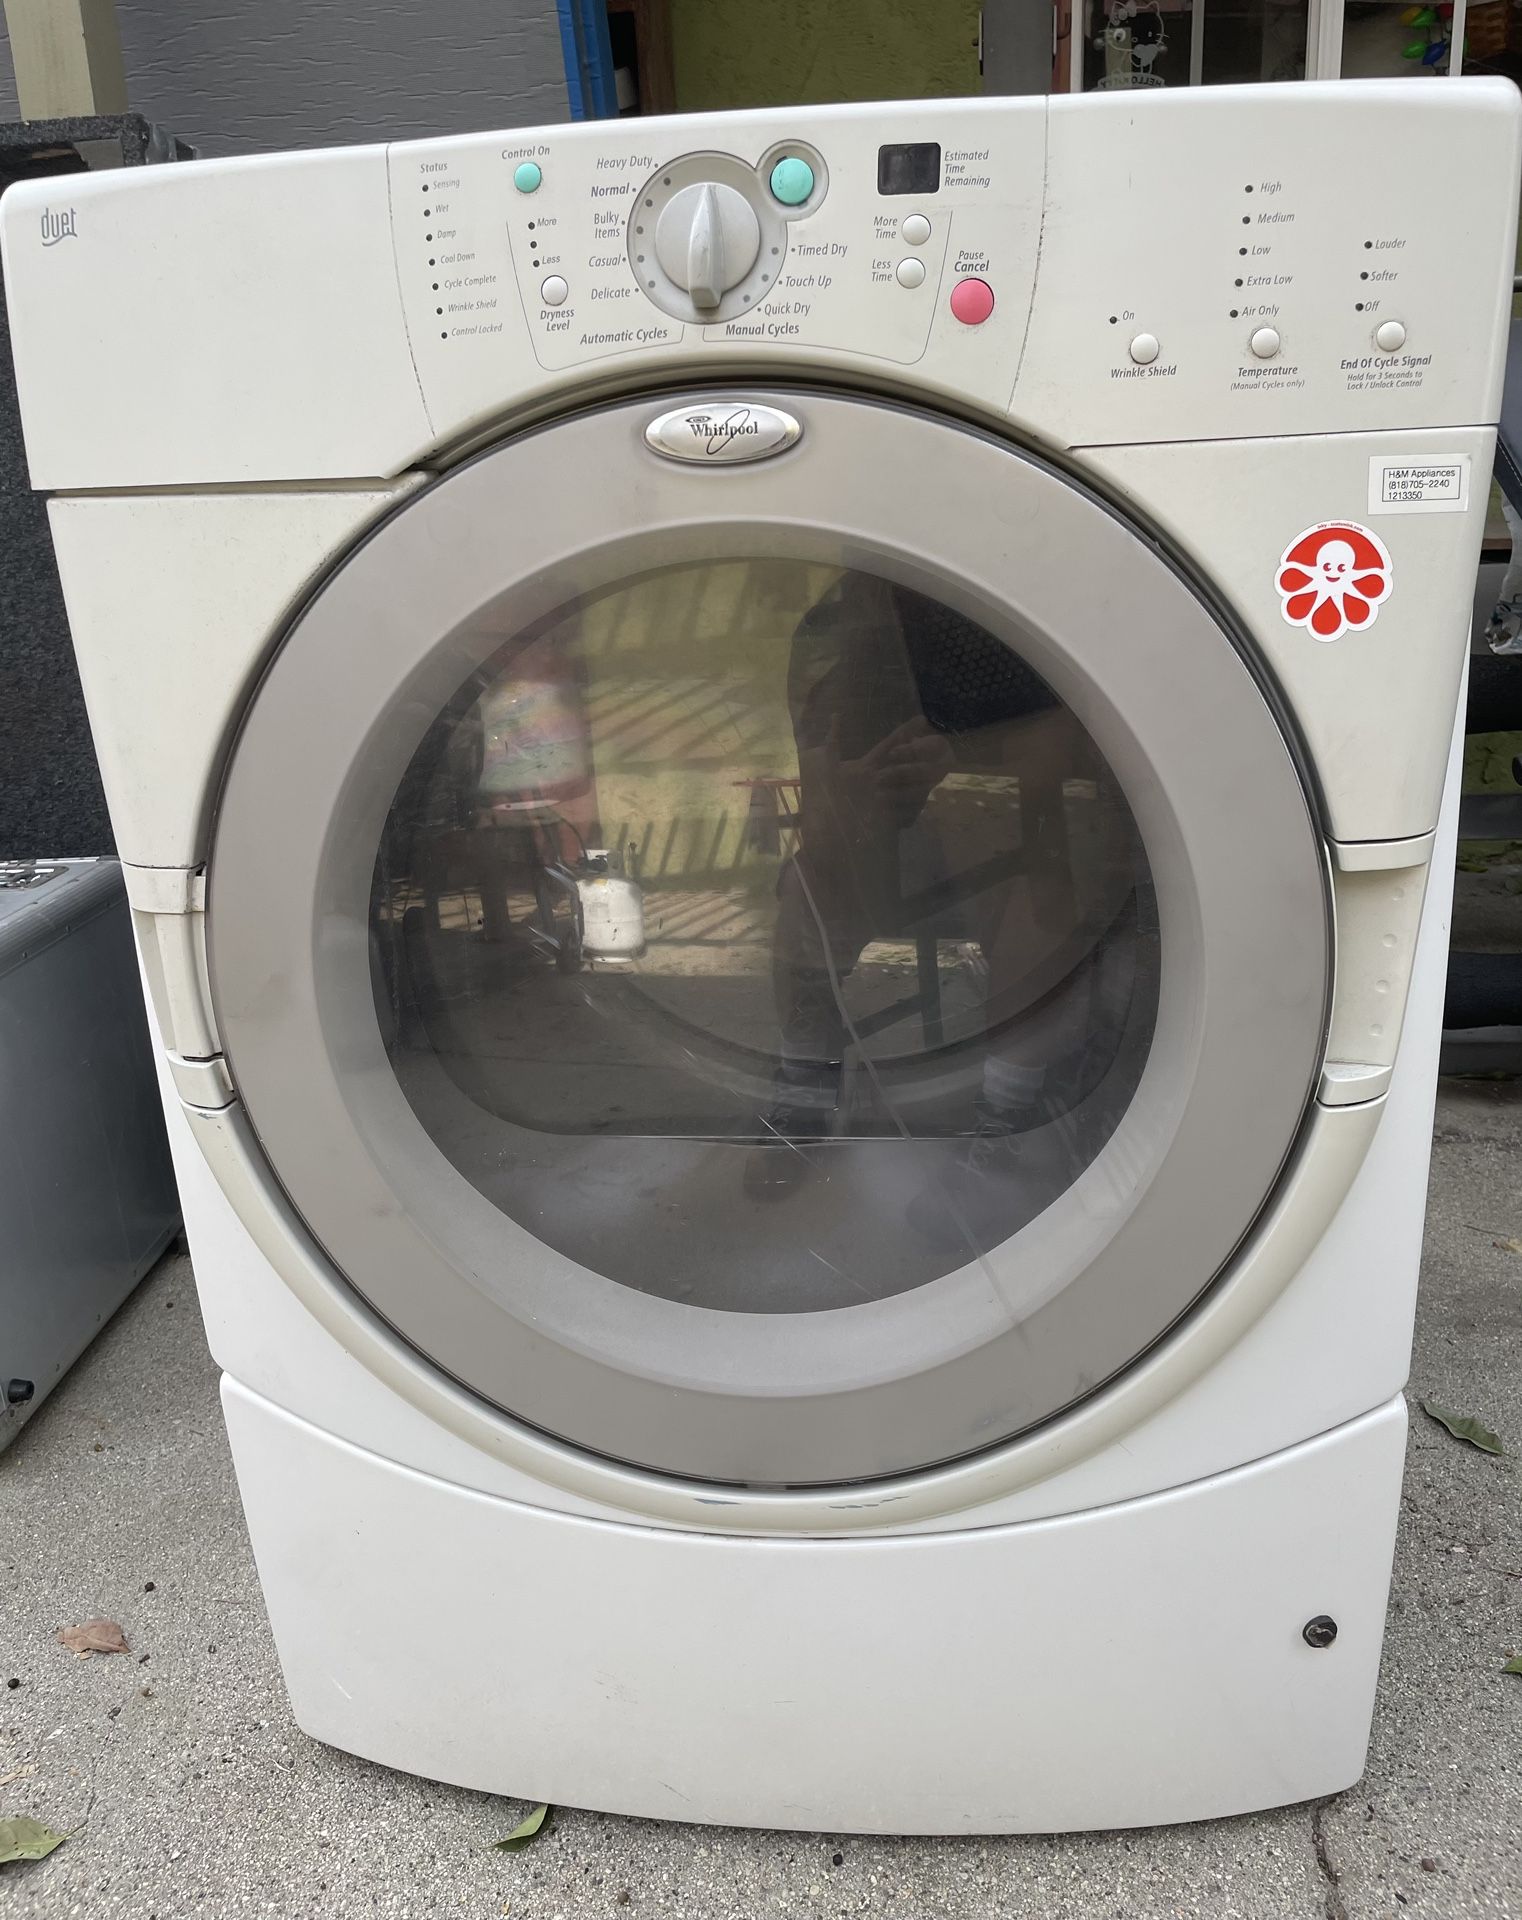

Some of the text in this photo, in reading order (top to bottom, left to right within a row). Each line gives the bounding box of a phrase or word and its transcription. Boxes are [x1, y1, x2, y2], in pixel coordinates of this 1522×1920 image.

[501, 146, 551, 160] Control On
[944, 150, 989, 162] Estimated
[596, 151, 653, 170] Heavy Duty
[420, 162, 448, 174] Status
[944, 163, 965, 174] Time
[433, 179, 460, 190] Sensing
[944, 176, 991, 188] Remaining
[1260, 181, 1282, 194] High
[591, 183, 630, 198] Normal
[435, 204, 449, 213] Wet
[537, 216, 557, 227] More
[594, 212, 620, 227] Bulky
[873, 216, 898, 227] More
[1257, 211, 1295, 224] Medium
[41, 207, 78, 247] duet
[594, 227, 620, 239] Items
[437, 230, 456, 239] Damp
[875, 229, 897, 240] Time
[1375, 238, 1407, 250] Louder
[797, 243, 848, 258] Timed Dry
[958, 250, 984, 262] Pause
[1251, 245, 1271, 256] Low
[440, 252, 476, 264] Cool Down
[542, 254, 561, 265] Less
[588, 254, 621, 267] Casual
[872, 259, 892, 270] Less
[954, 259, 989, 273] Cancel
[444, 274, 497, 290] Cycle Complete
[785, 275, 832, 289] Touch Up
[871, 271, 893, 282] Time
[1247, 274, 1293, 287] Extra Low
[1370, 270, 1398, 282] Softer
[591, 288, 631, 300] Delicate
[448, 299, 497, 313] Wrinkle Shield
[764, 302, 811, 317] Quick Dry
[1241, 304, 1280, 318] Air Only
[1364, 300, 1380, 312] Off
[540, 309, 575, 322] Dryness
[1122, 310, 1135, 321] On
[451, 322, 503, 337] Control Locked
[546, 320, 570, 332] Level
[726, 323, 800, 337] Manual Cycles
[580, 327, 668, 346] Automatic Cycles
[1340, 354, 1433, 370] End Of Cycle Signal
[1111, 365, 1177, 379] Wrinkle Shield
[1237, 365, 1299, 378] Temperature
[1347, 373, 1365, 382] Hold
[1366, 372, 1378, 381] for
[1384, 371, 1412, 380] Seconds
[1413, 370, 1424, 379] to
[1230, 379, 1306, 391] (Manual Cycles only)
[1347, 382, 1364, 391] Lock
[1370, 380, 1395, 389] Unlock
[1395, 378, 1423, 388] Control
[690, 421, 758, 438] Whirlpool
[1388, 469, 1456, 479] H&M Appliances
[1388, 479, 1450, 490] (818)705-2240
[1388, 491, 1423, 500] 1213350
